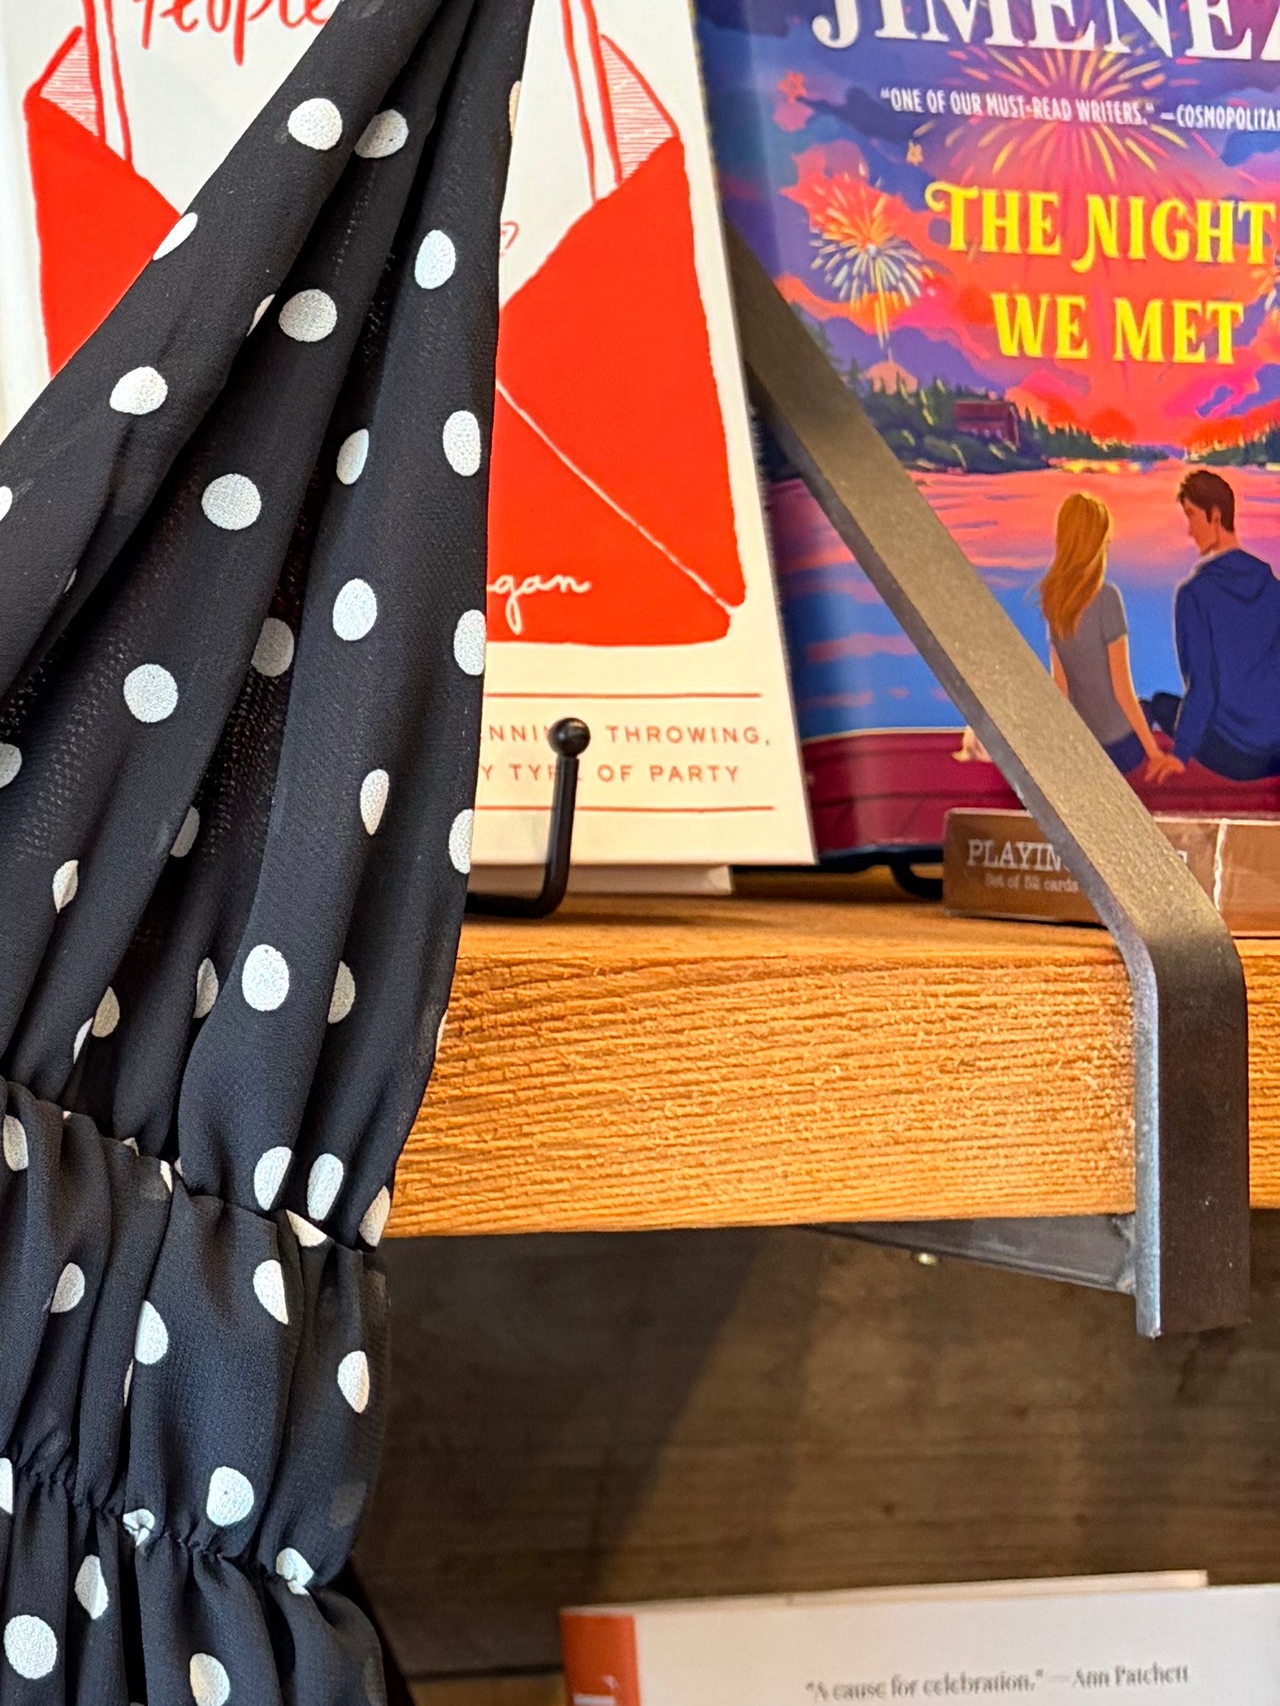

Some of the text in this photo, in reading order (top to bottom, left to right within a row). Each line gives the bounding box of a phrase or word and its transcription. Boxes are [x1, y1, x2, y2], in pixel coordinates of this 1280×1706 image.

[927, 90, 946, 114] OF
[950, 92, 982, 115] OUR
[985, 95, 1072, 122] MUST-READ
[925, 181, 1276, 271] THE NIGHT
[991, 291, 1244, 364] WE MET
[488, 573, 593, 635] gan
[597, 764, 633, 782] OF
[649, 764, 739, 783] PARTY
[967, 838, 1071, 873] PLAYIN
[832, 1680, 886, 1700] cause
[890, 1673, 918, 1698] for
[1114, 1661, 1189, 1686] Patchett
